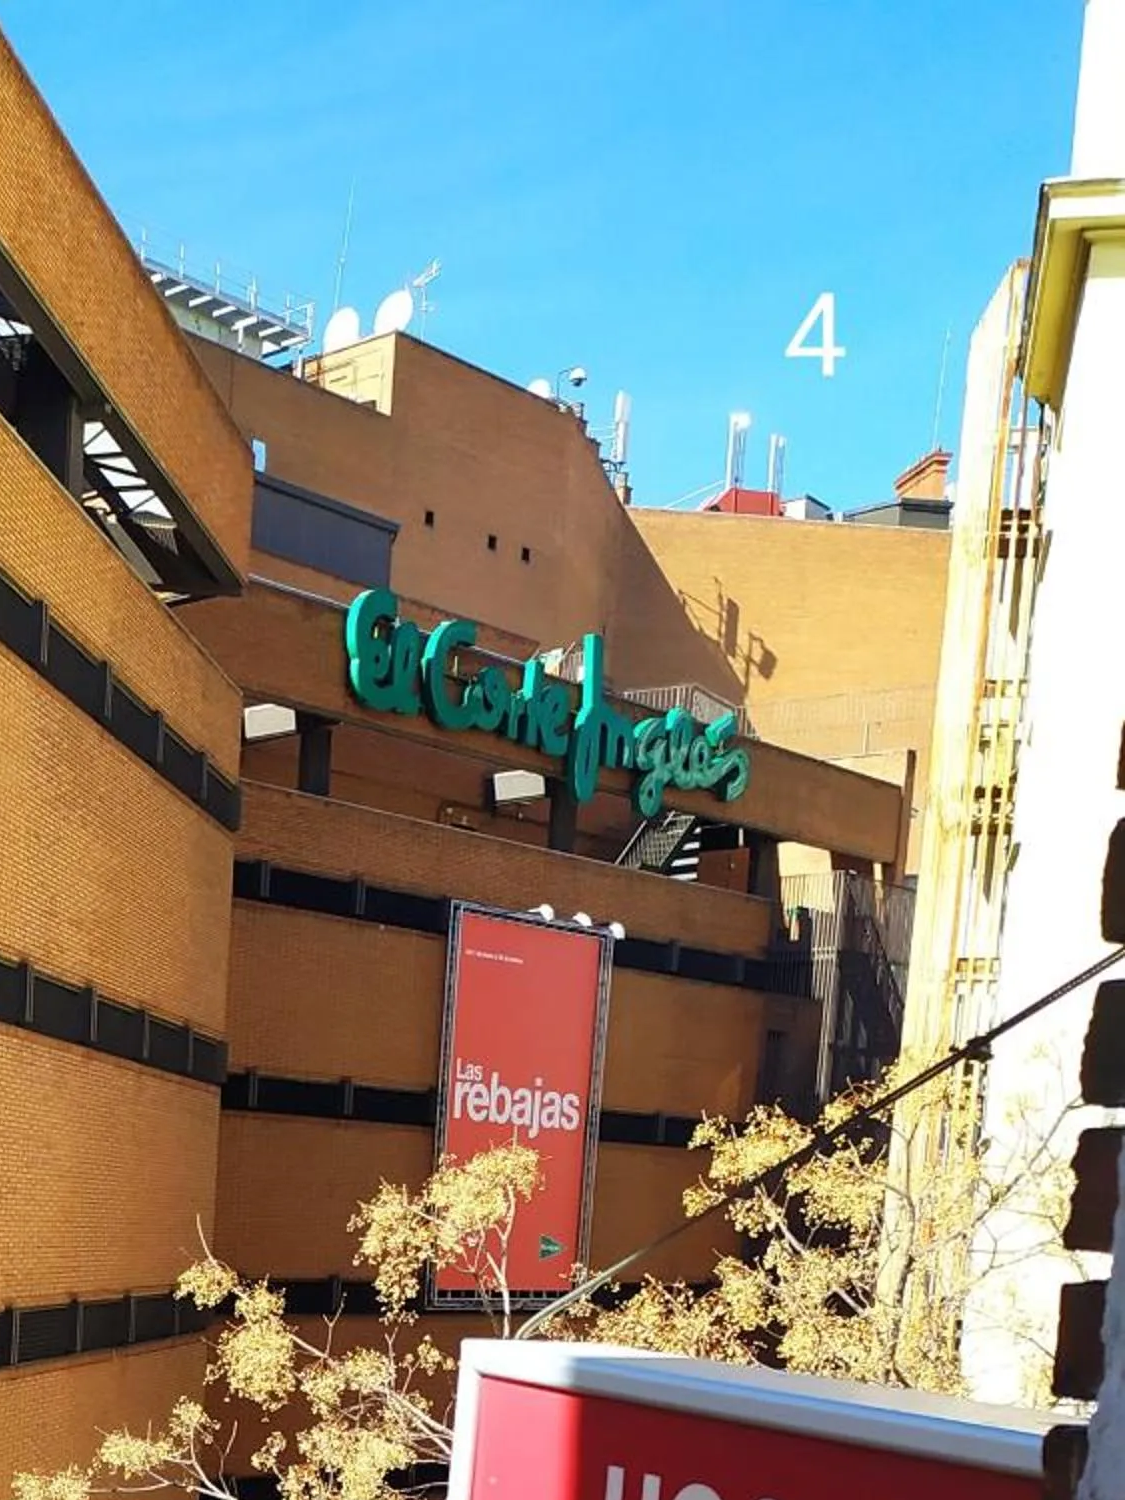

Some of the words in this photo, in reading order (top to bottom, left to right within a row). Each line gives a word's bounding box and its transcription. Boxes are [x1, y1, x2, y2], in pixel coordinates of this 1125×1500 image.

[346, 587, 421, 717] El
[421, 618, 572, 758] Corte
[456, 1056, 484, 1081] Las
[453, 1071, 581, 1139] rebajas
